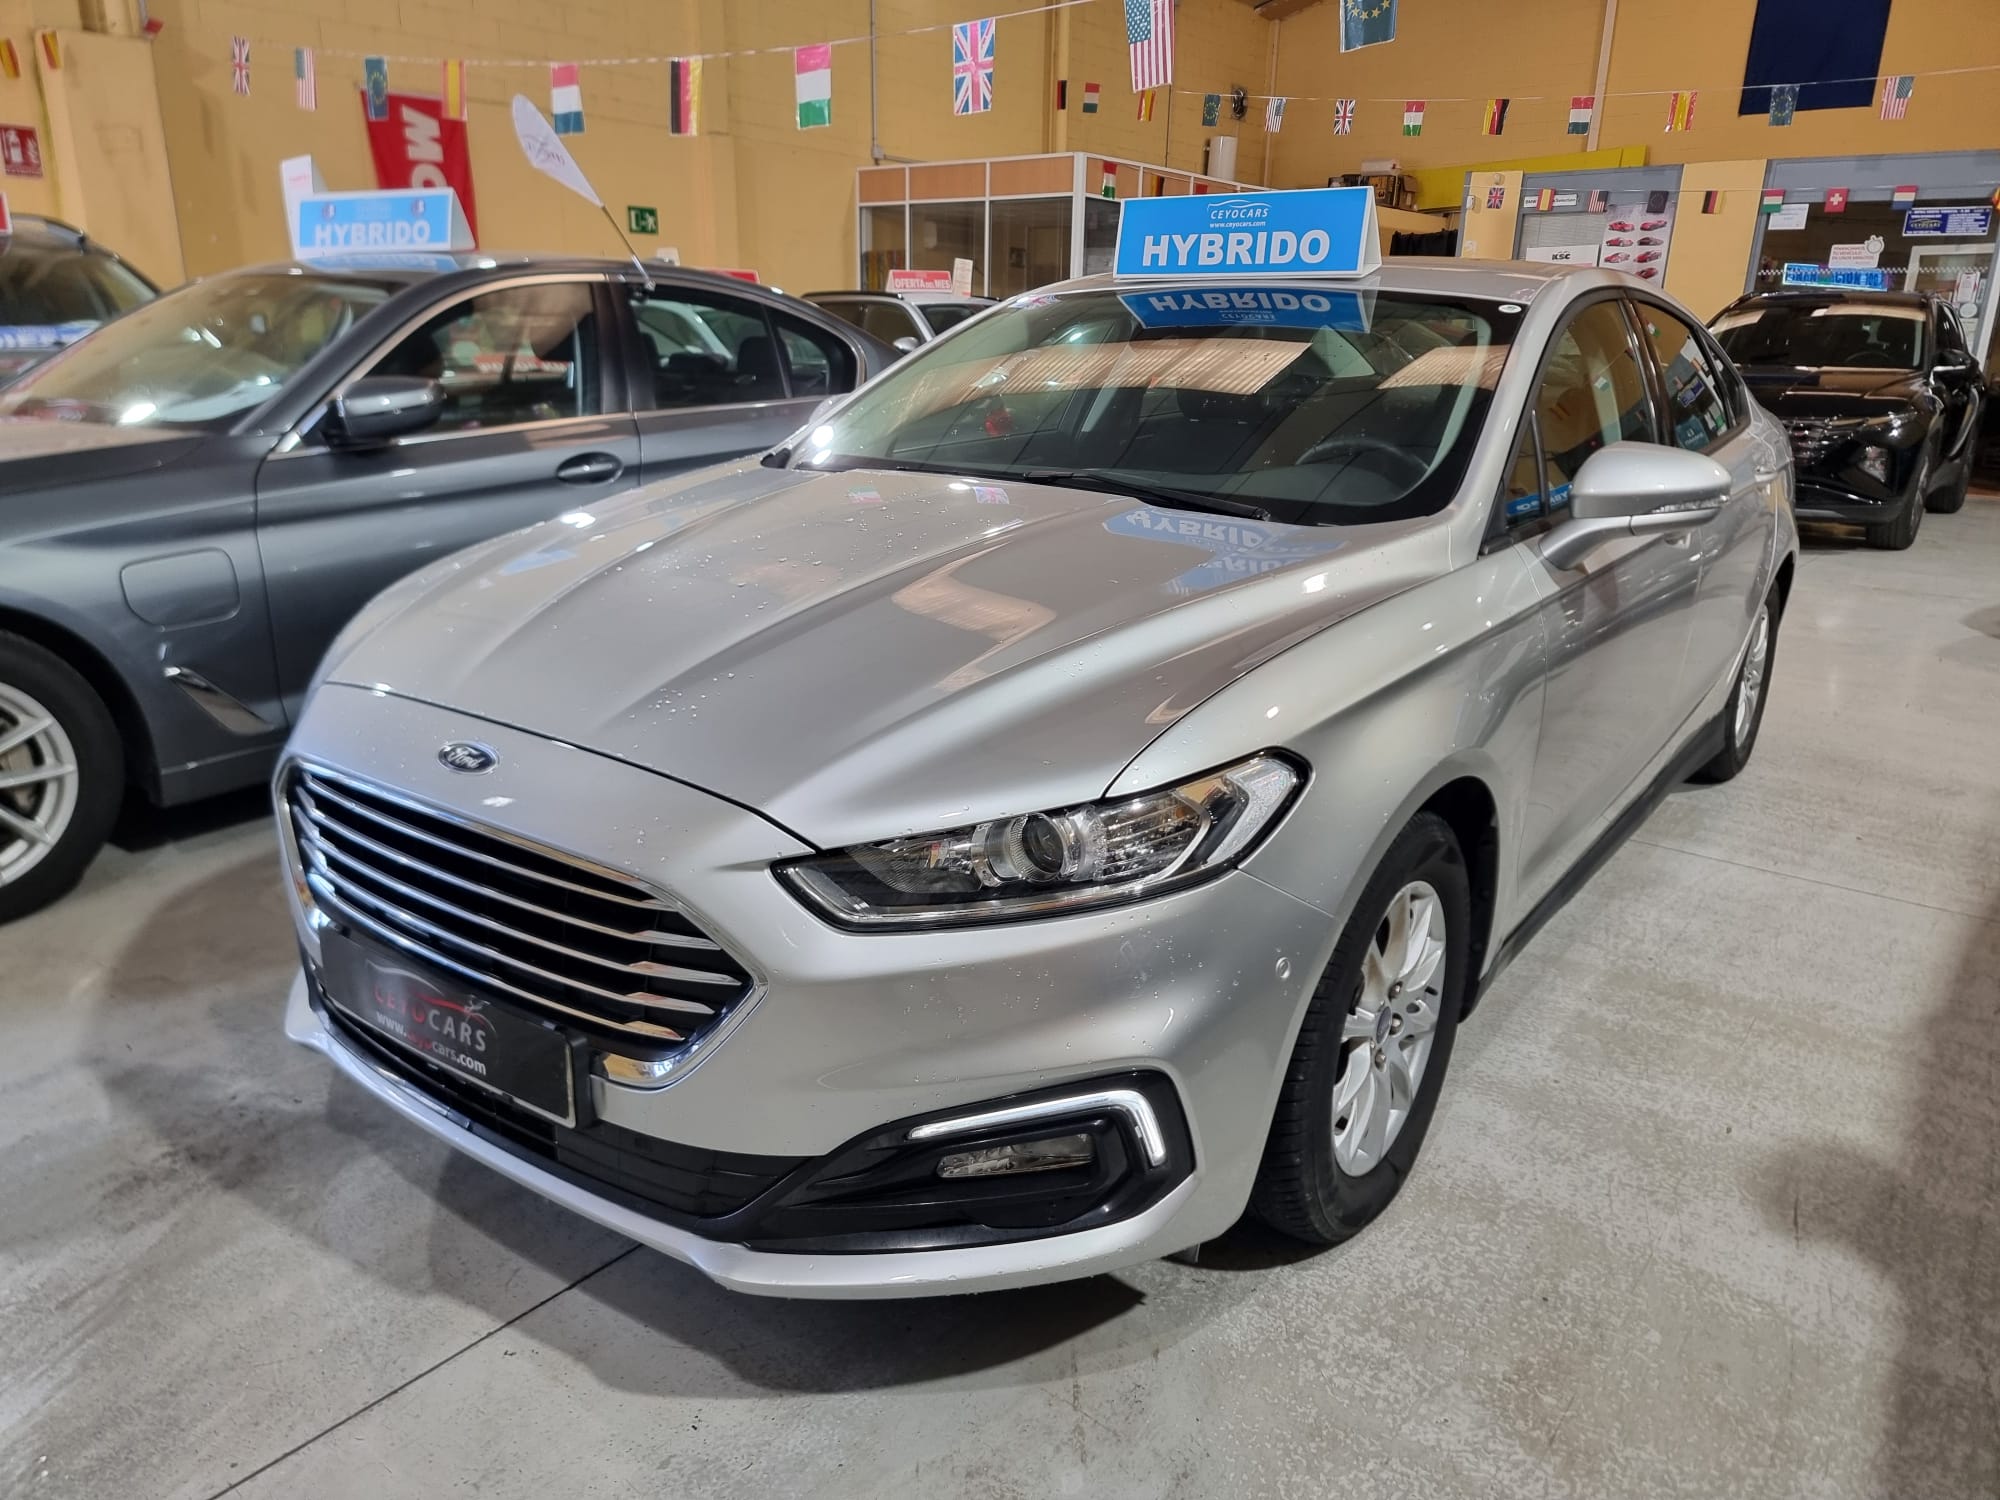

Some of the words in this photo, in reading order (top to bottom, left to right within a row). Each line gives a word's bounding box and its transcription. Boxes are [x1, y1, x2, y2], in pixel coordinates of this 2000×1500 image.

[1210, 207, 1269, 220] CEYOCARS
[314, 219, 431, 248] HYBRIDO
[1209, 220, 1266, 229] www.ceyocars.com
[1142, 229, 1331, 267] HYBRIDO
[895, 279, 925, 289] OFERTA
[934, 280, 951, 289] MES
[448, 746, 486, 769] Ford
